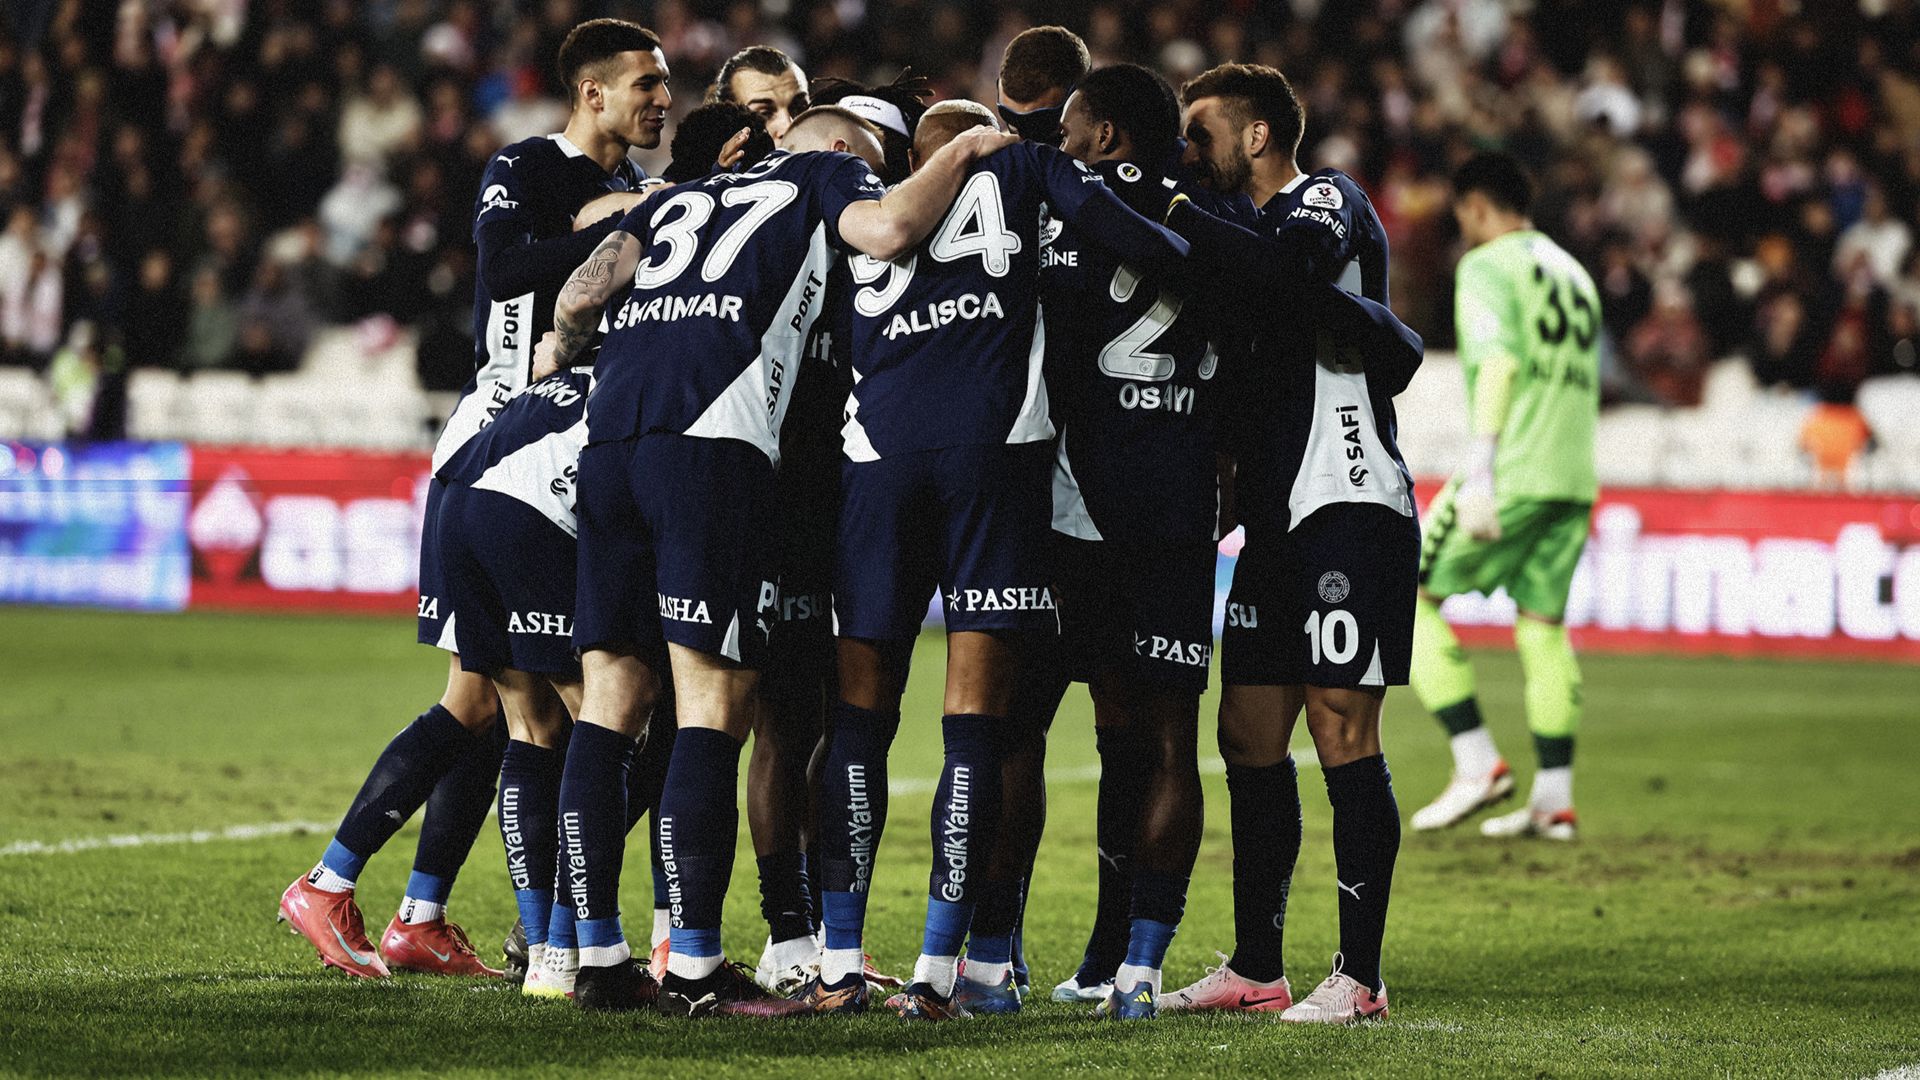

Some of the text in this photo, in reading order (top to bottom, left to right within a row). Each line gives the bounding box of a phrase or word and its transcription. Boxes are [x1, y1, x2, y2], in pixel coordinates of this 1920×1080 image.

[634, 180, 799, 289] 37
[790, 270, 823, 333] PORT
[1119, 381, 1196, 416] OSAYI
[963, 587, 1056, 612] PASHA
[1304, 609, 1359, 666] 10
